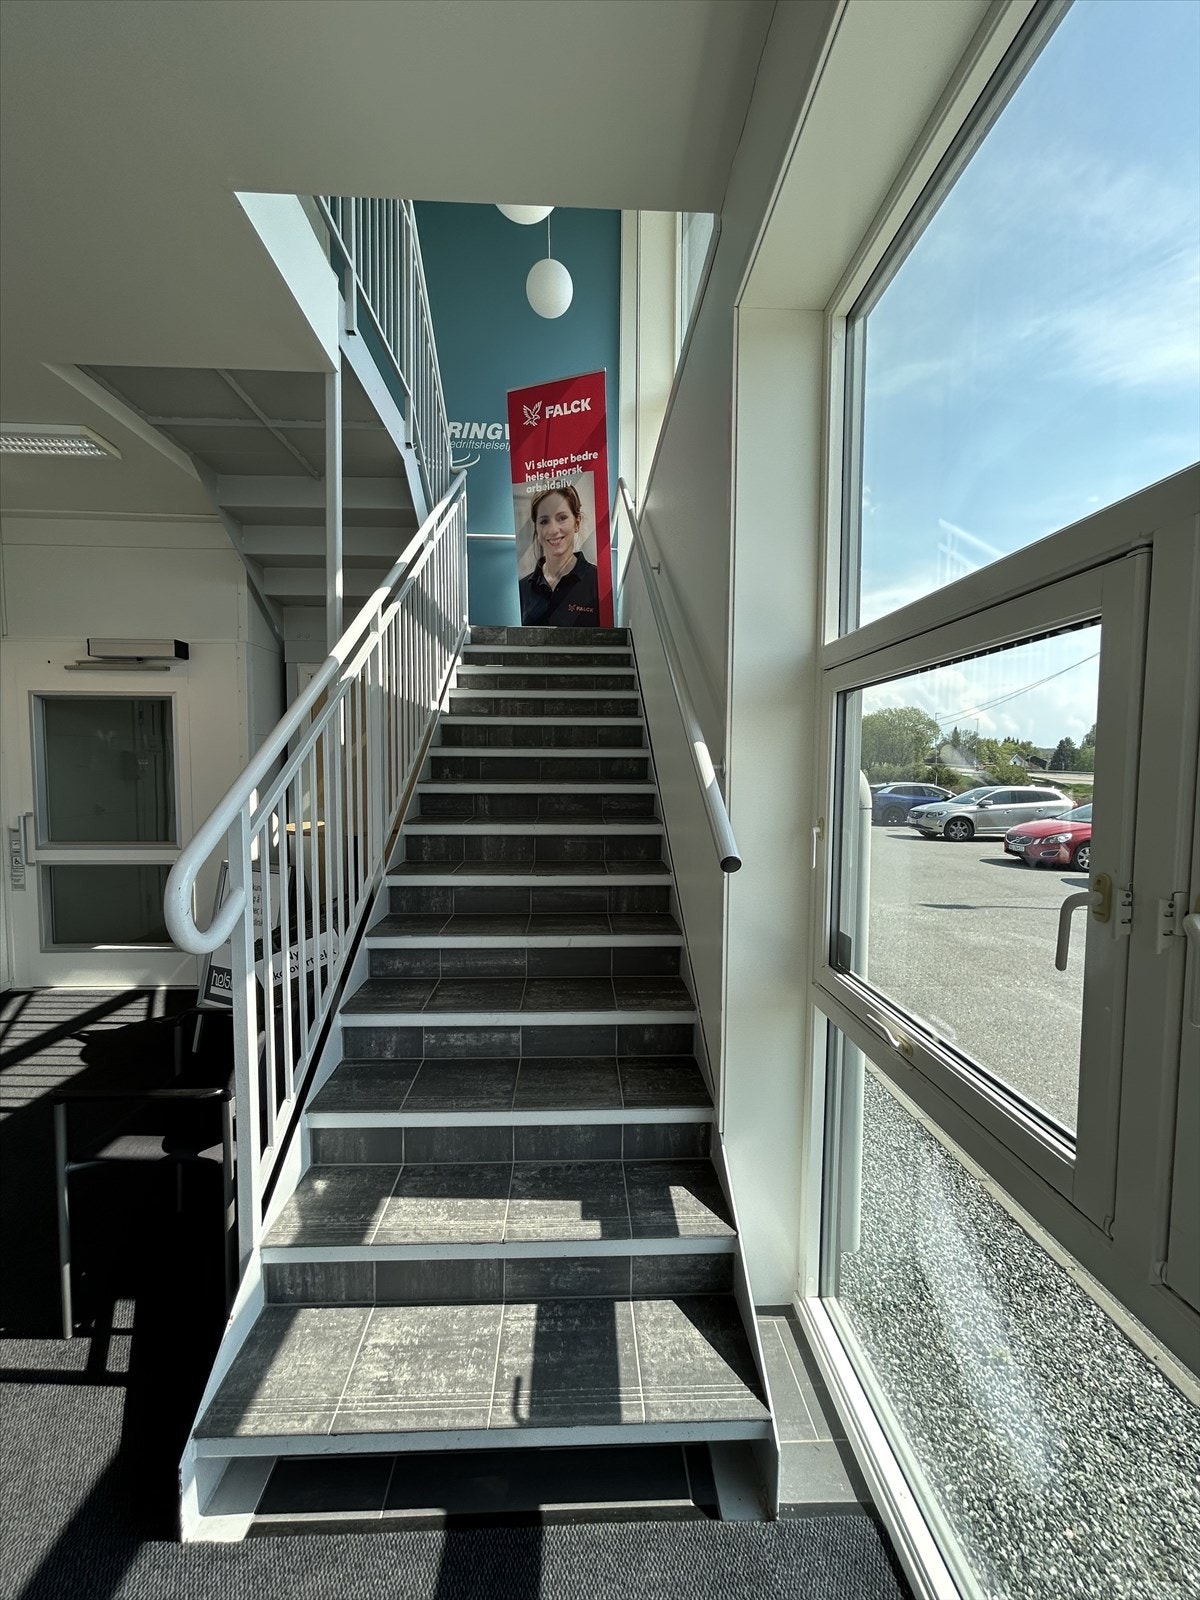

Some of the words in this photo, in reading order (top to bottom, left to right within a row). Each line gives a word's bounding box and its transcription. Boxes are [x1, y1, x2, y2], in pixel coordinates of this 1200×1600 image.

[545, 397, 591, 419] FALCK
[525, 460, 535, 471] Vi
[536, 456, 569, 469] skaper
[570, 450, 599, 463] bedre
[525, 471, 550, 482] helse
[551, 469, 555, 478] i
[556, 464, 583, 477] norsk
[526, 478, 572, 493] arbeidsliv
